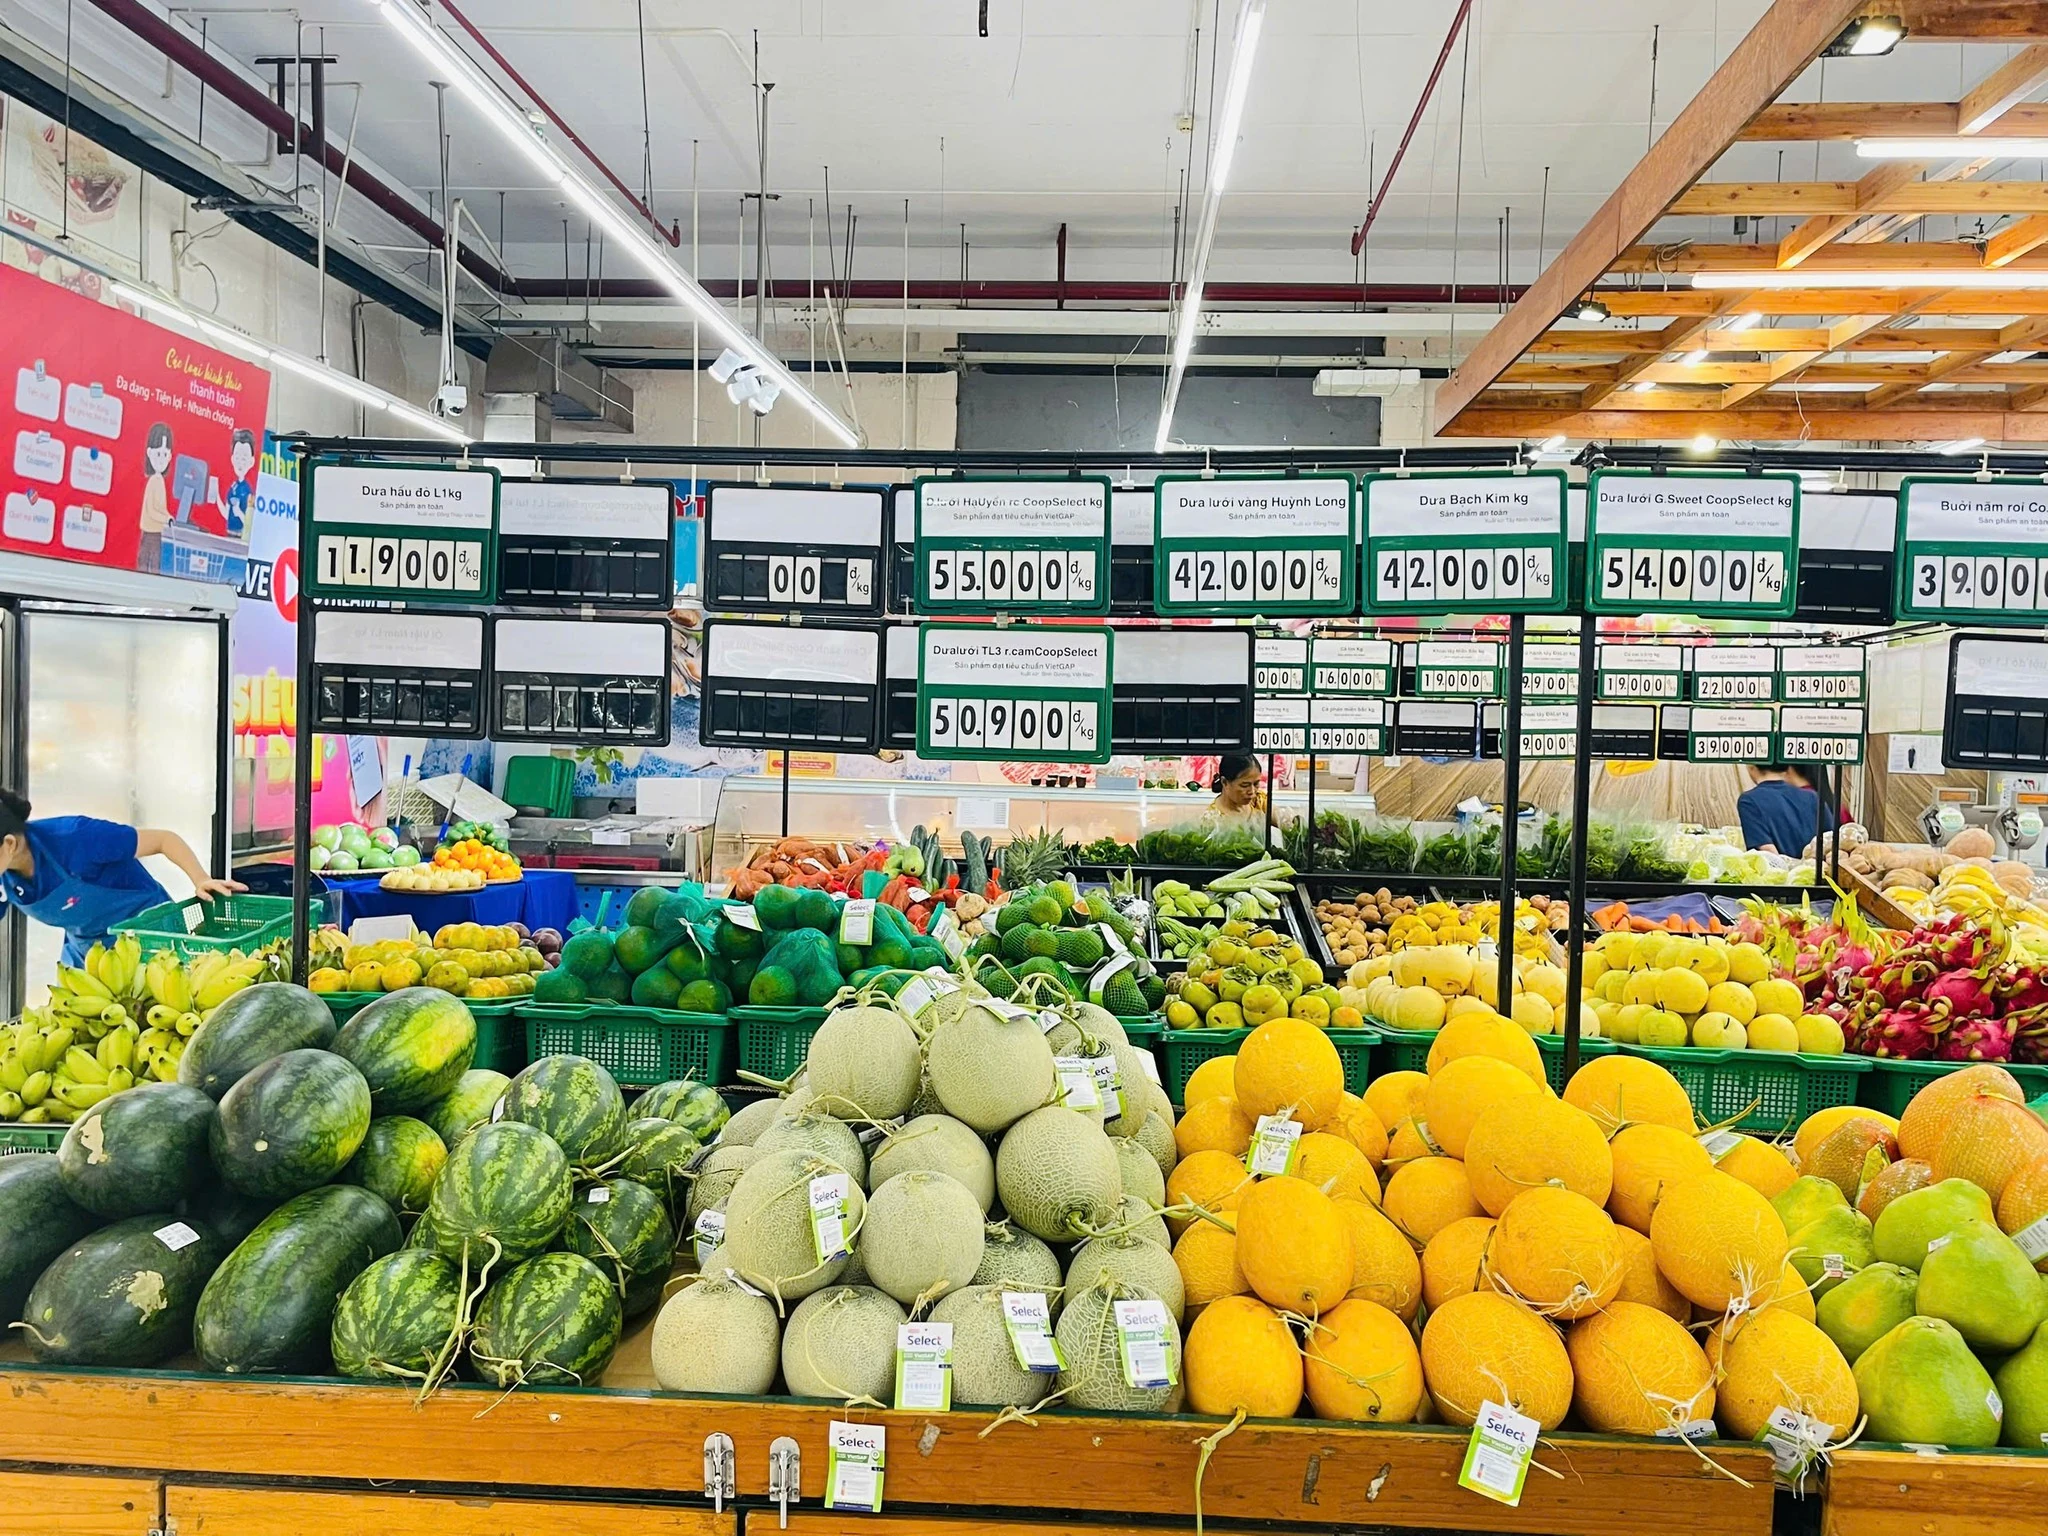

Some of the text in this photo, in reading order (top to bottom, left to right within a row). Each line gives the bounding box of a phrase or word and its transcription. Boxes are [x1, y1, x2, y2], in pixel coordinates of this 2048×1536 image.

[190, 380, 236, 408] thanh toán
[116, 375, 234, 429] Đa dạng Tiện lợi Nhanh chóng
[362, 485, 387, 497] Dưa
[390, 484, 412, 498] hấu
[415, 487, 430, 498] đỏ
[1023, 497, 1087, 509] CoopSelect
[1089, 497, 1103, 509] kg
[1179, 496, 1346, 510] Dưa lưới vàng Huỳnh Long
[1420, 493, 1529, 507] Dưa Bạch Kim kg
[1600, 493, 1792, 508] Dưa lưới G.Sweet CoopSelect kg
[1941, 499, 1972, 512] Bưởi
[1976, 501, 2003, 512] năm
[1044, 512, 1076, 520] VietGAP
[328, 544, 449, 582] 11.900
[236, 562, 270, 596] VE
[774, 564, 815, 595] 00
[934, 558, 1062, 592] 55.000
[1174, 558, 1306, 591] 42.000
[1383, 554, 1519, 591] 42.000
[1607, 555, 1747, 591] 54.000
[933, 645, 1098, 659] Dưalưới TL3 r.camCoopSelect
[1045, 662, 1075, 670] VietGAP
[1258, 671, 1289, 685] 000
[1319, 670, 1372, 685] 16.000
[1425, 673, 1480, 687] 19.000
[1522, 675, 1565, 690] 9.900
[1607, 677, 1663, 692] 19.000
[1701, 680, 1756, 696] 22.000
[1789, 678, 1847, 693] 18.900
[934, 704, 1063, 739] 50.900
[1254, 732, 1291, 746] .000
[1312, 732, 1366, 746] 19.900
[1522, 737, 1566, 751] 9.000
[1697, 740, 1754, 754] 39.000
[1787, 741, 1843, 755] 28.000
[1094, 1066, 1110, 1076] ect
[814, 1188, 839, 1204] Select
[1011, 1305, 1042, 1317] Select
[1124, 1313, 1160, 1326] Select
[907, 1335, 942, 1346] Select
[1486, 1417, 1526, 1443] Select
[838, 1436, 876, 1449] Select
